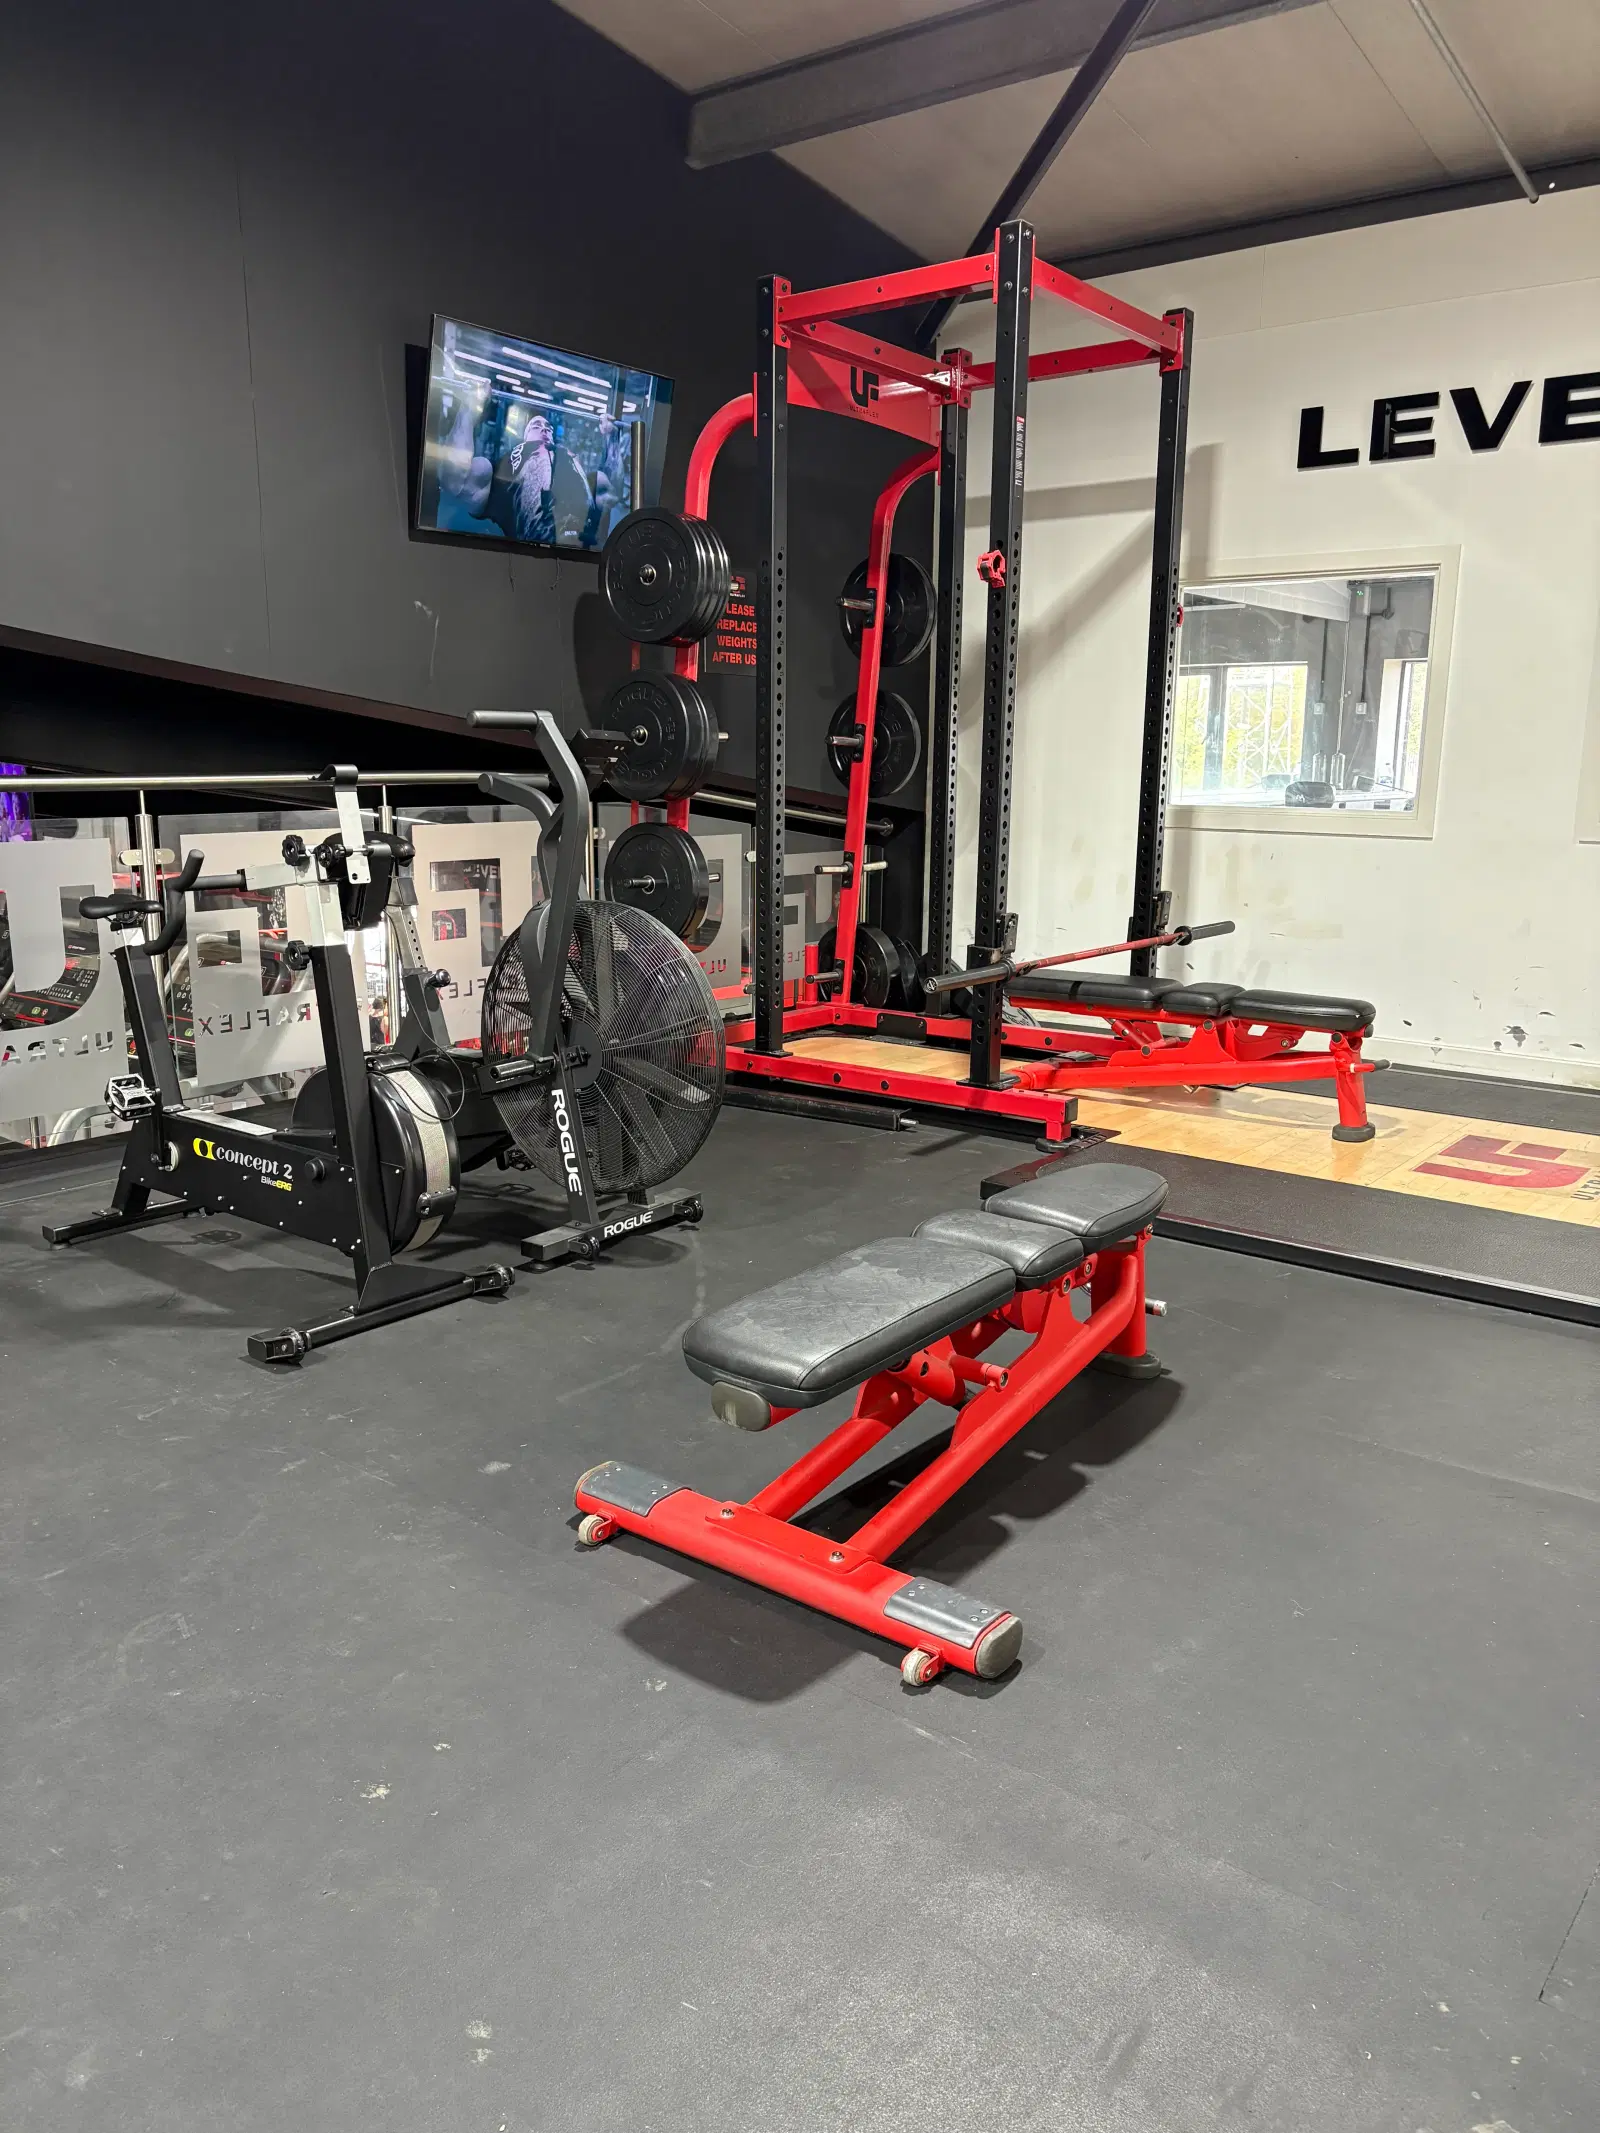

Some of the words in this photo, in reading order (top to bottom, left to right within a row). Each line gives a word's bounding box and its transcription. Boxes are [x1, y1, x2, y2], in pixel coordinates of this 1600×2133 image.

[725, 603, 755, 617] LEASE
[716, 619, 757, 633] REPLACE
[717, 635, 757, 649] WEIGHTS
[712, 651, 742, 664] AFTER
[744, 654, 757, 665] US
[551, 1088, 583, 1197] ROGUE
[216, 1146, 279, 1175] concept
[283, 1163, 293, 1180] 2
[260, 1175, 293, 1192] BikeERG
[604, 1210, 654, 1238] ROGUE
